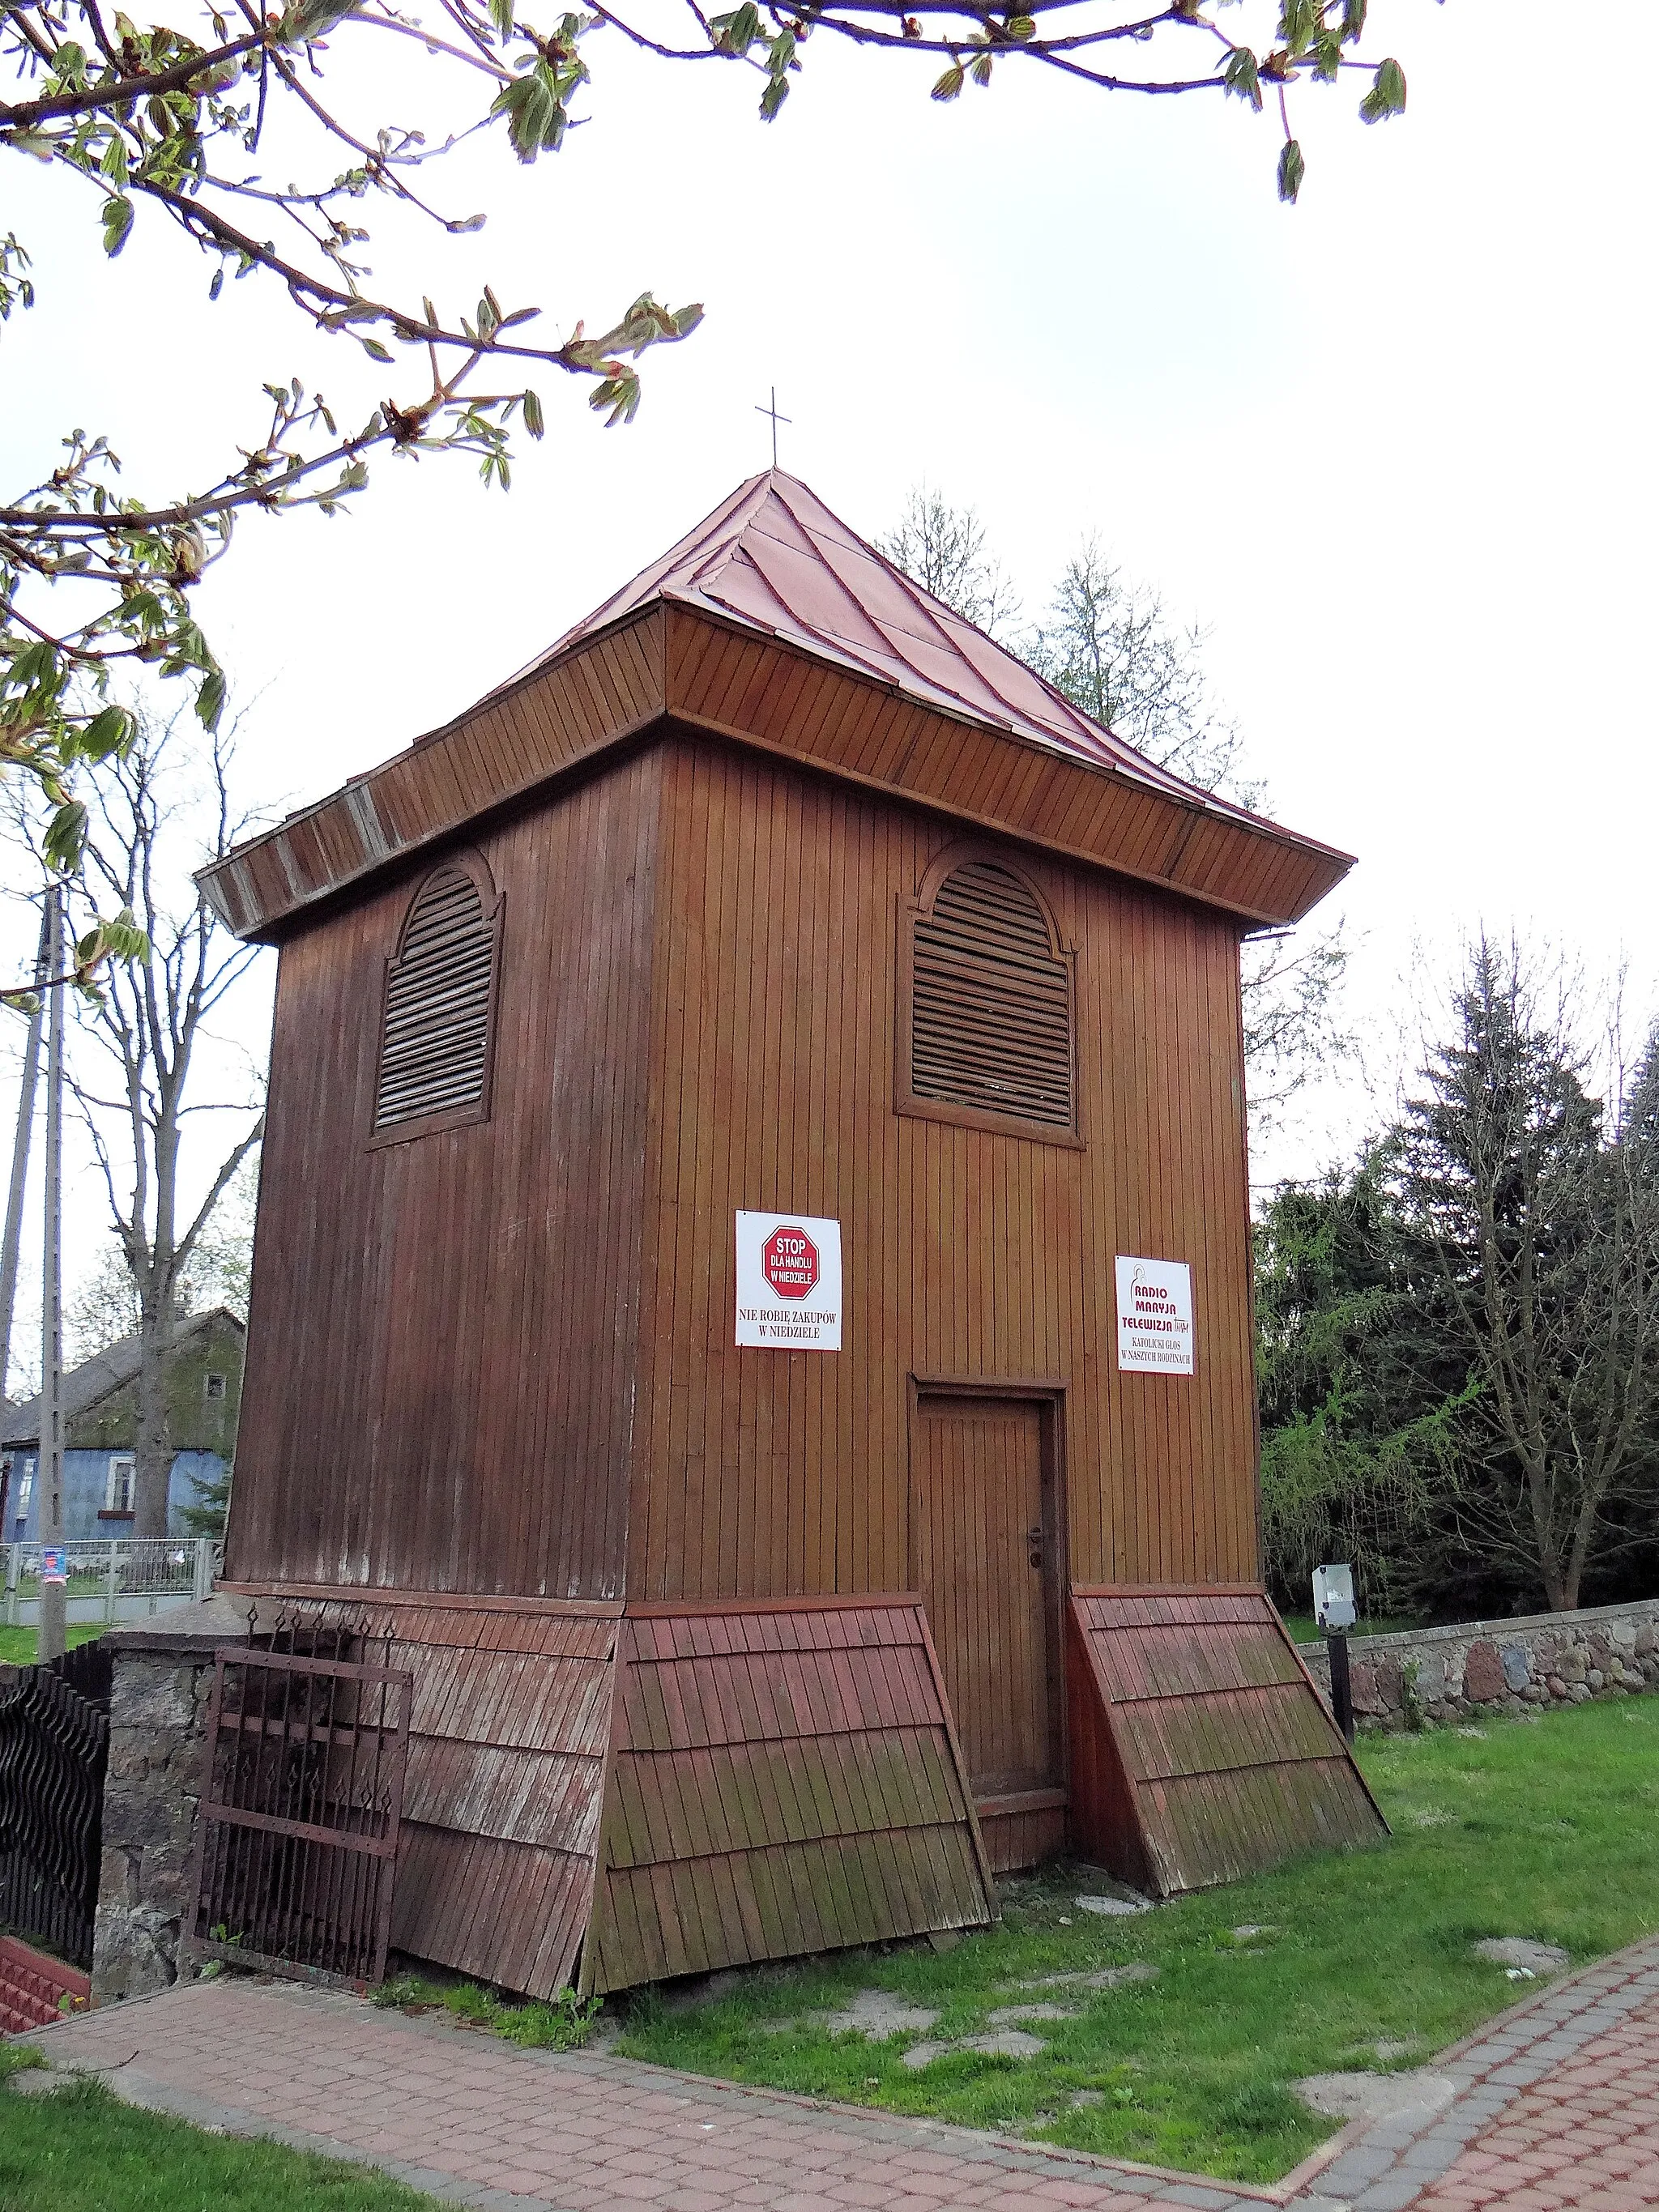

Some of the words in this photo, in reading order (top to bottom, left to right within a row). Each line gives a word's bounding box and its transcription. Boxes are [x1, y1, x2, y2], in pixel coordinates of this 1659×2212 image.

[776, 1237, 806, 1255] STOP
[770, 1255, 785, 1268] DLA
[785, 1255, 812, 1269] HANDLU
[770, 1270, 778, 1282] W
[778, 1271, 812, 1285] NIEDZIELE
[1135, 1285, 1167, 1299] RADIO
[1136, 1300, 1176, 1315] MARYJA
[739, 1308, 757, 1321] NIE
[760, 1310, 791, 1325] ROBIĘ
[792, 1310, 837, 1324] ZAKUPÓW
[1122, 1316, 1172, 1332] TELEWIZJA
[758, 1325, 768, 1337] W
[770, 1325, 820, 1339] NIEDZIELE
[1132, 1336, 1165, 1349] KATOLICKI
[1121, 1349, 1127, 1360] W
[1128, 1349, 1156, 1362] NASZYCH
[1157, 1352, 1191, 1365] RODZINACH
